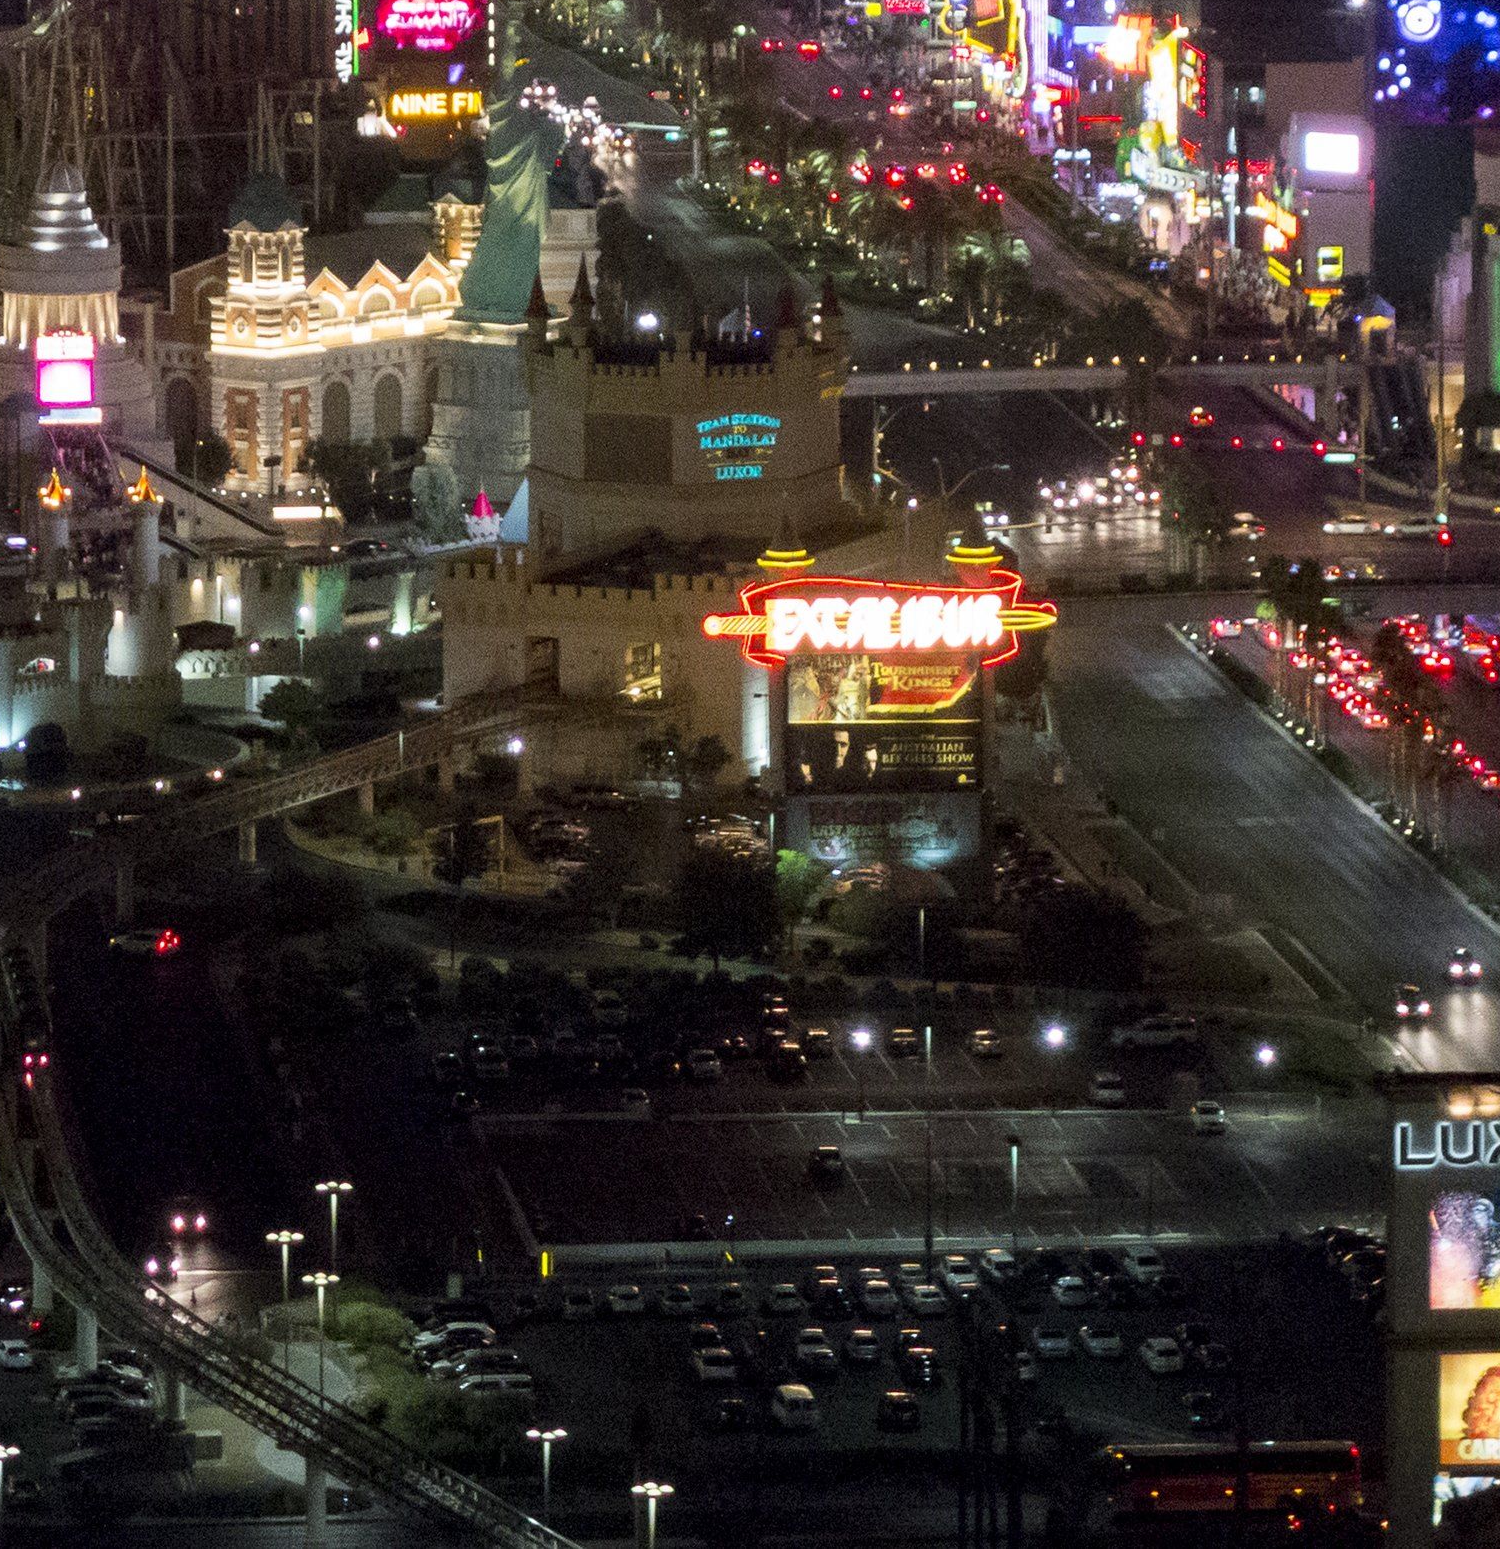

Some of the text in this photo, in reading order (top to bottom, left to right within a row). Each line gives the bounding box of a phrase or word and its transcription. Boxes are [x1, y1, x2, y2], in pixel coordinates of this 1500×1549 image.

[392, 93, 448, 115] NINE
[696, 413, 781, 433] TRAM STATION
[700, 433, 777, 449] MANDALAY
[715, 465, 763, 480] LUXOR
[771, 594, 1003, 651] EXCALIBUR
[937, 753, 975, 763] SHOW
